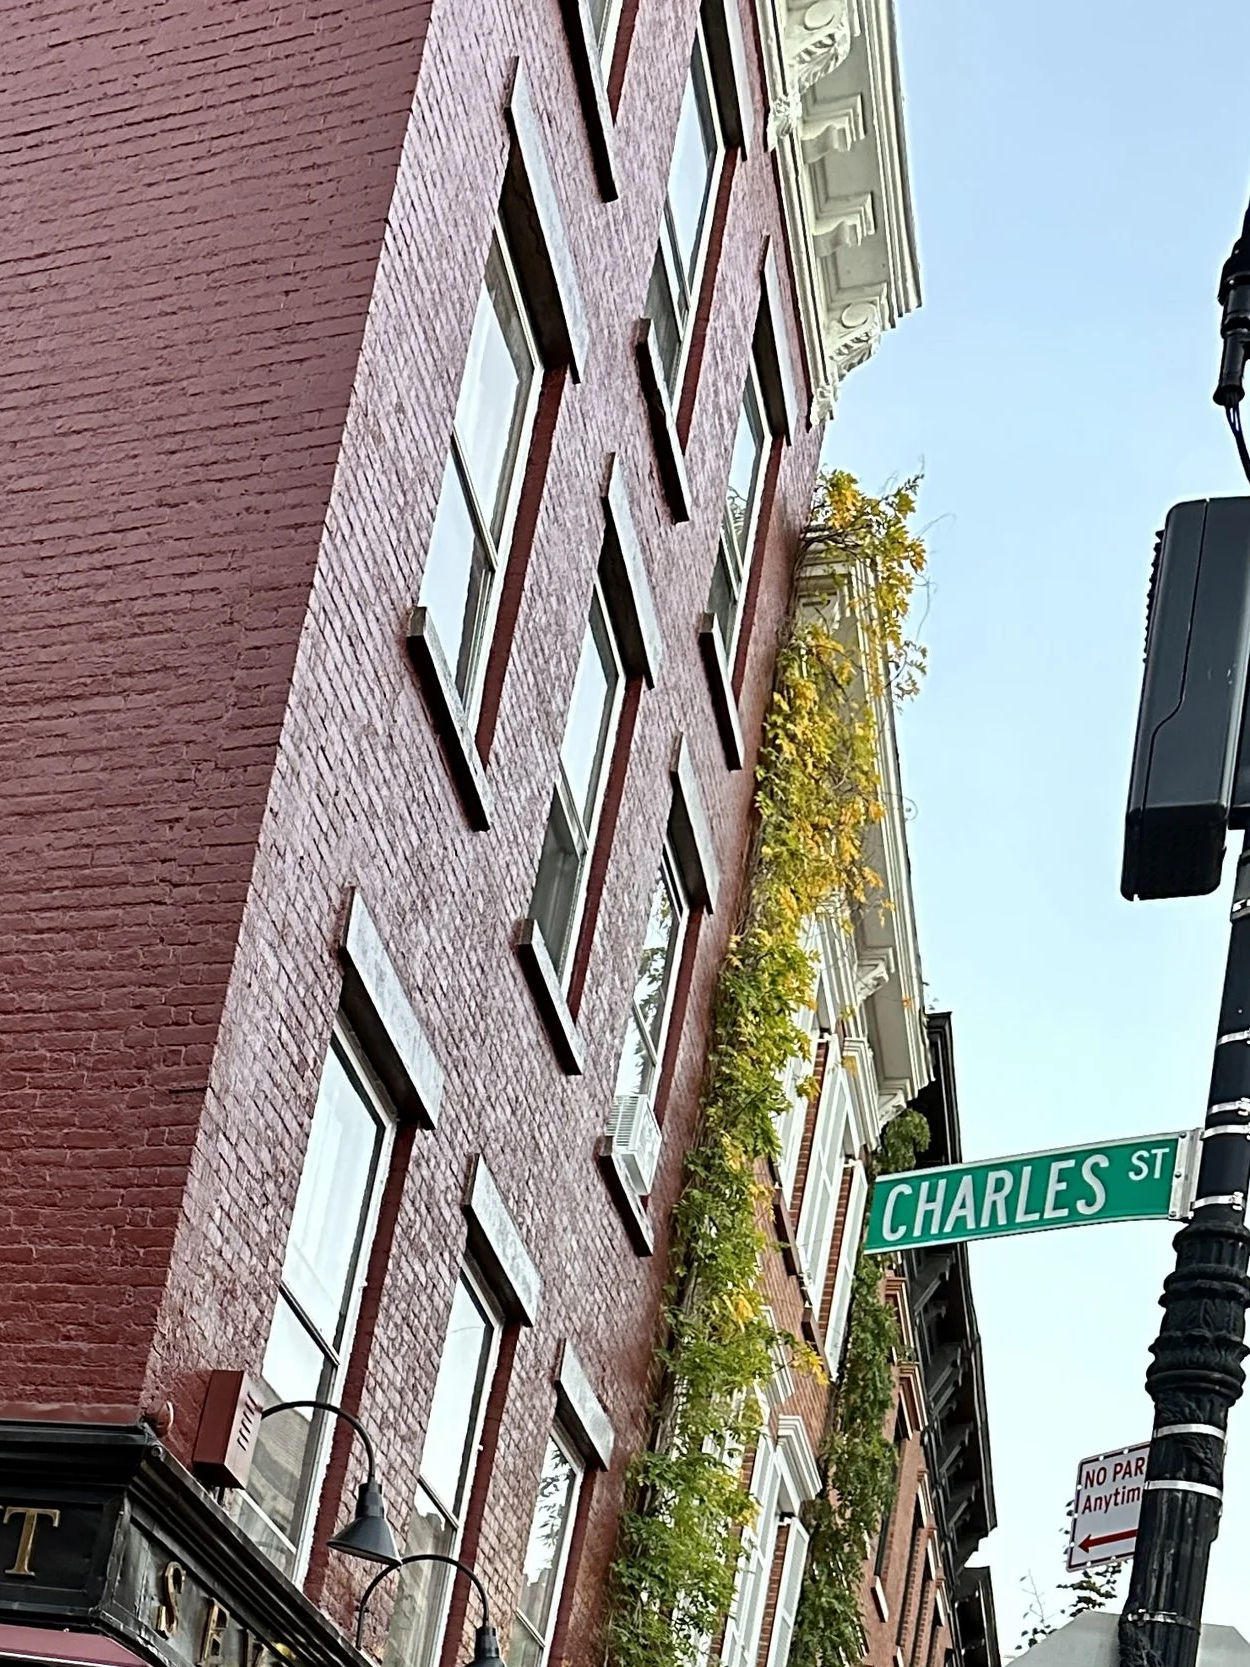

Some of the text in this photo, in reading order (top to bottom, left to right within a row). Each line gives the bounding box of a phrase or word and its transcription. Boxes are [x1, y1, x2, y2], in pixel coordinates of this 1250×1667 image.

[882, 1147, 1170, 1242] CHARLES ST
[1084, 1466, 1107, 1490] NO
[1081, 1485, 1141, 1515] Anytim
